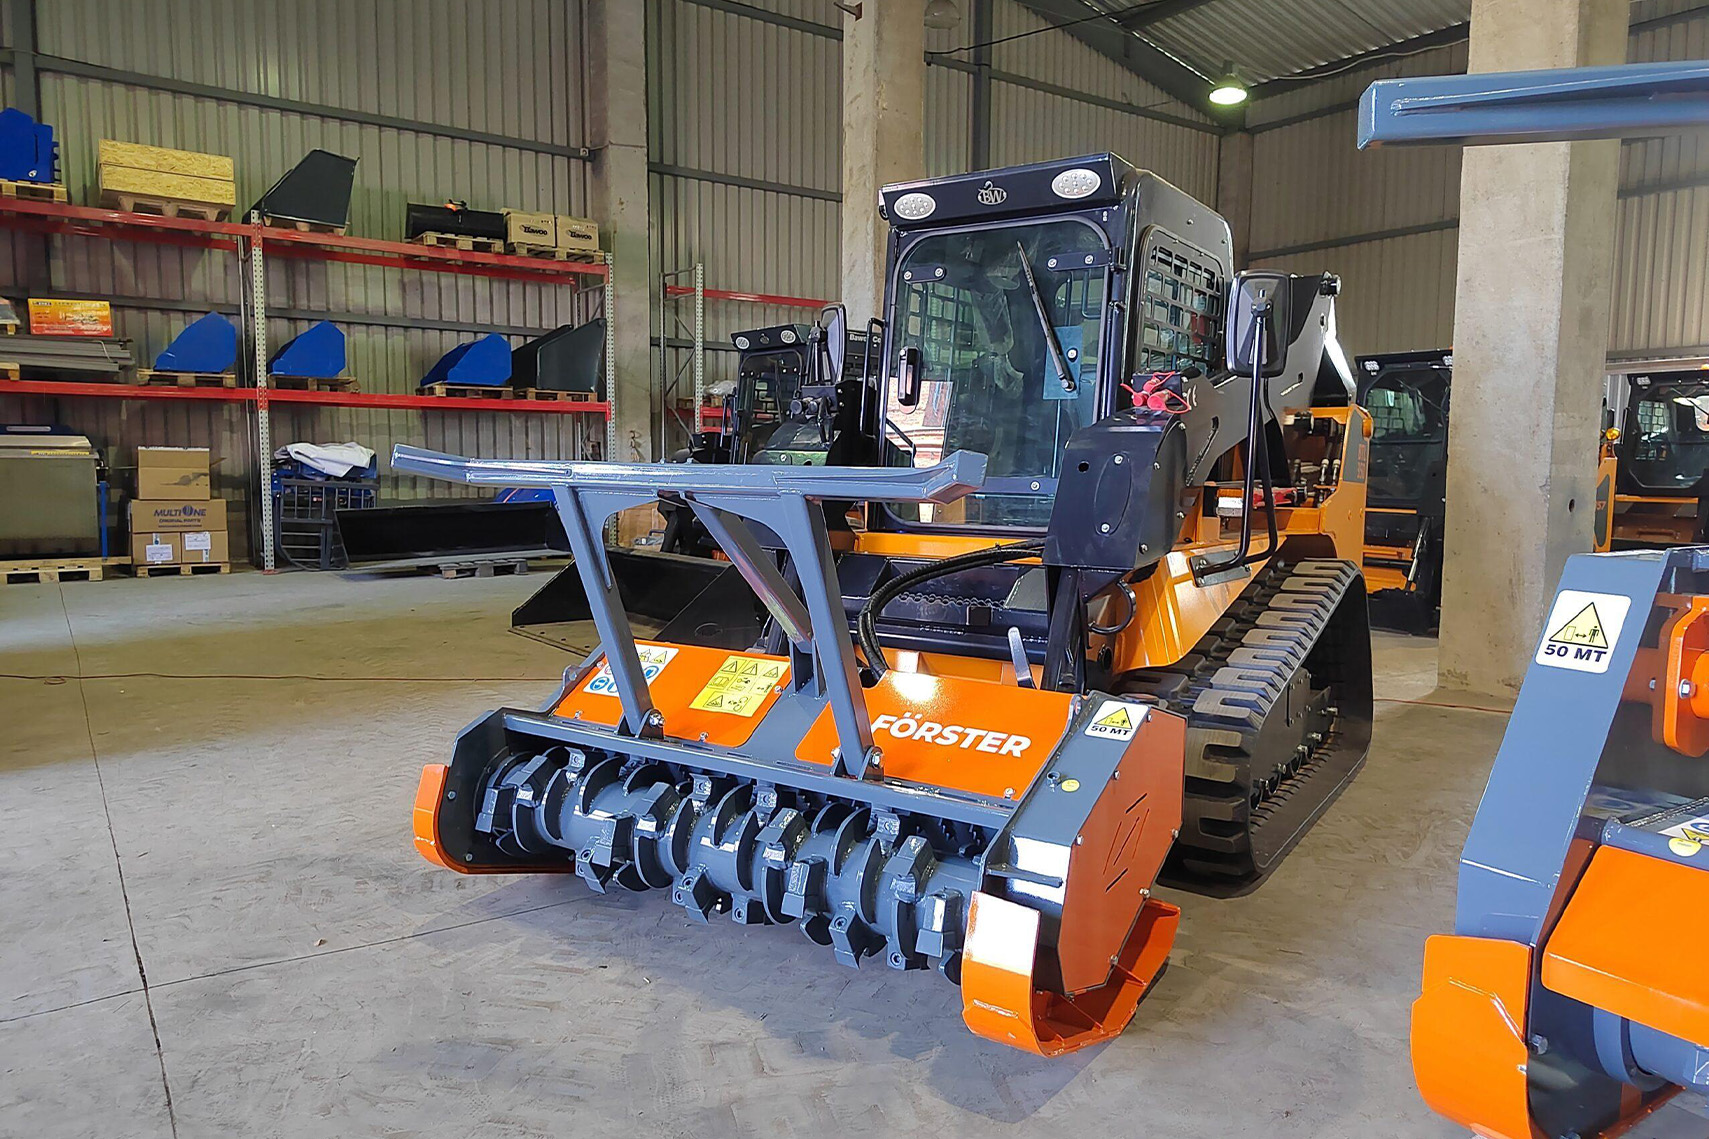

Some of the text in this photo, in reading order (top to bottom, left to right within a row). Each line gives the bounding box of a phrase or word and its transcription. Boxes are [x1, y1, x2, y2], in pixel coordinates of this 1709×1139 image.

[1544, 644, 1608, 663] 50 MT
[871, 711, 1032, 758] FÖRSTER
[1090, 725, 1132, 736] 50 MT
